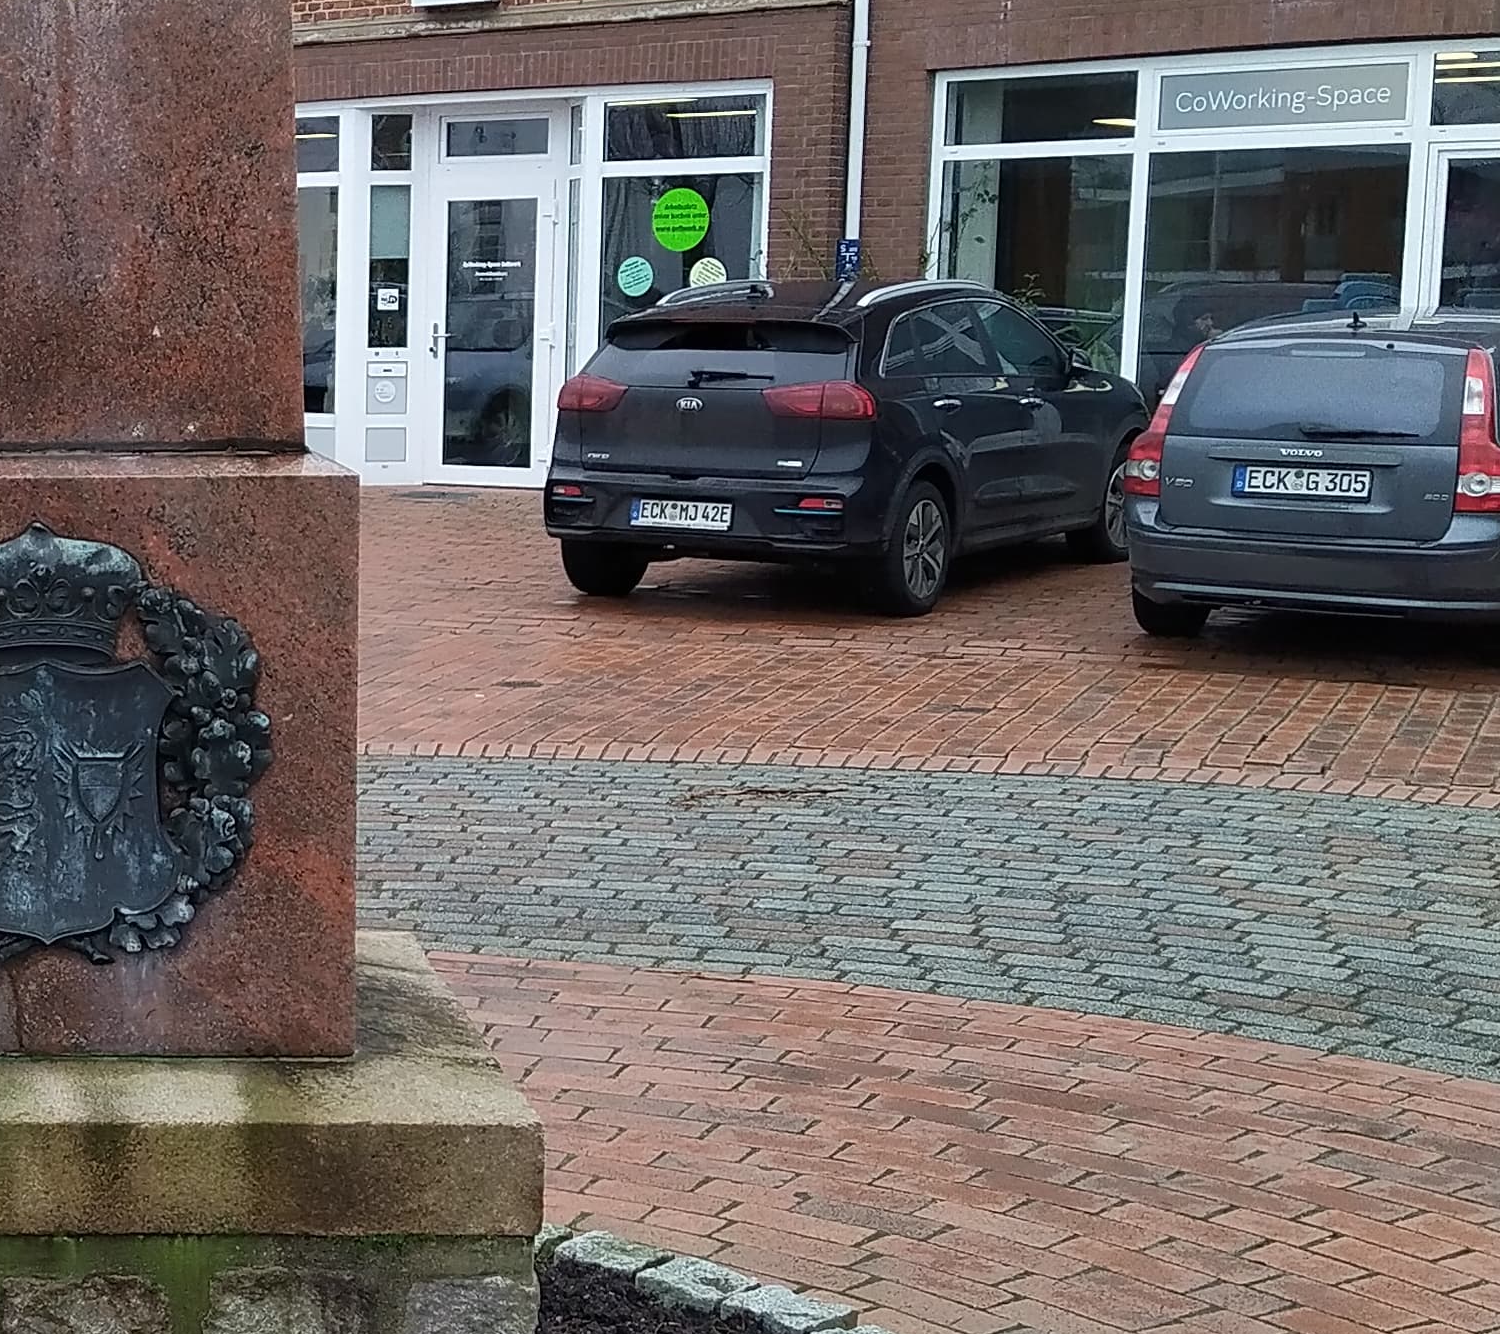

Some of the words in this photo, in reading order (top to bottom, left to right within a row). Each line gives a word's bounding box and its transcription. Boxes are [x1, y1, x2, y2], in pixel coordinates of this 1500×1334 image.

[1175, 84, 1392, 114] CoWorking-Space
[1280, 448, 1323, 457] VOLVO
[1247, 469, 1291, 491] ECK
[1306, 471, 1320, 492] G
[1324, 472, 1368, 493] 305
[640, 502, 669, 520] ECK
[679, 504, 698, 521] MJ
[701, 505, 729, 523] 42E
